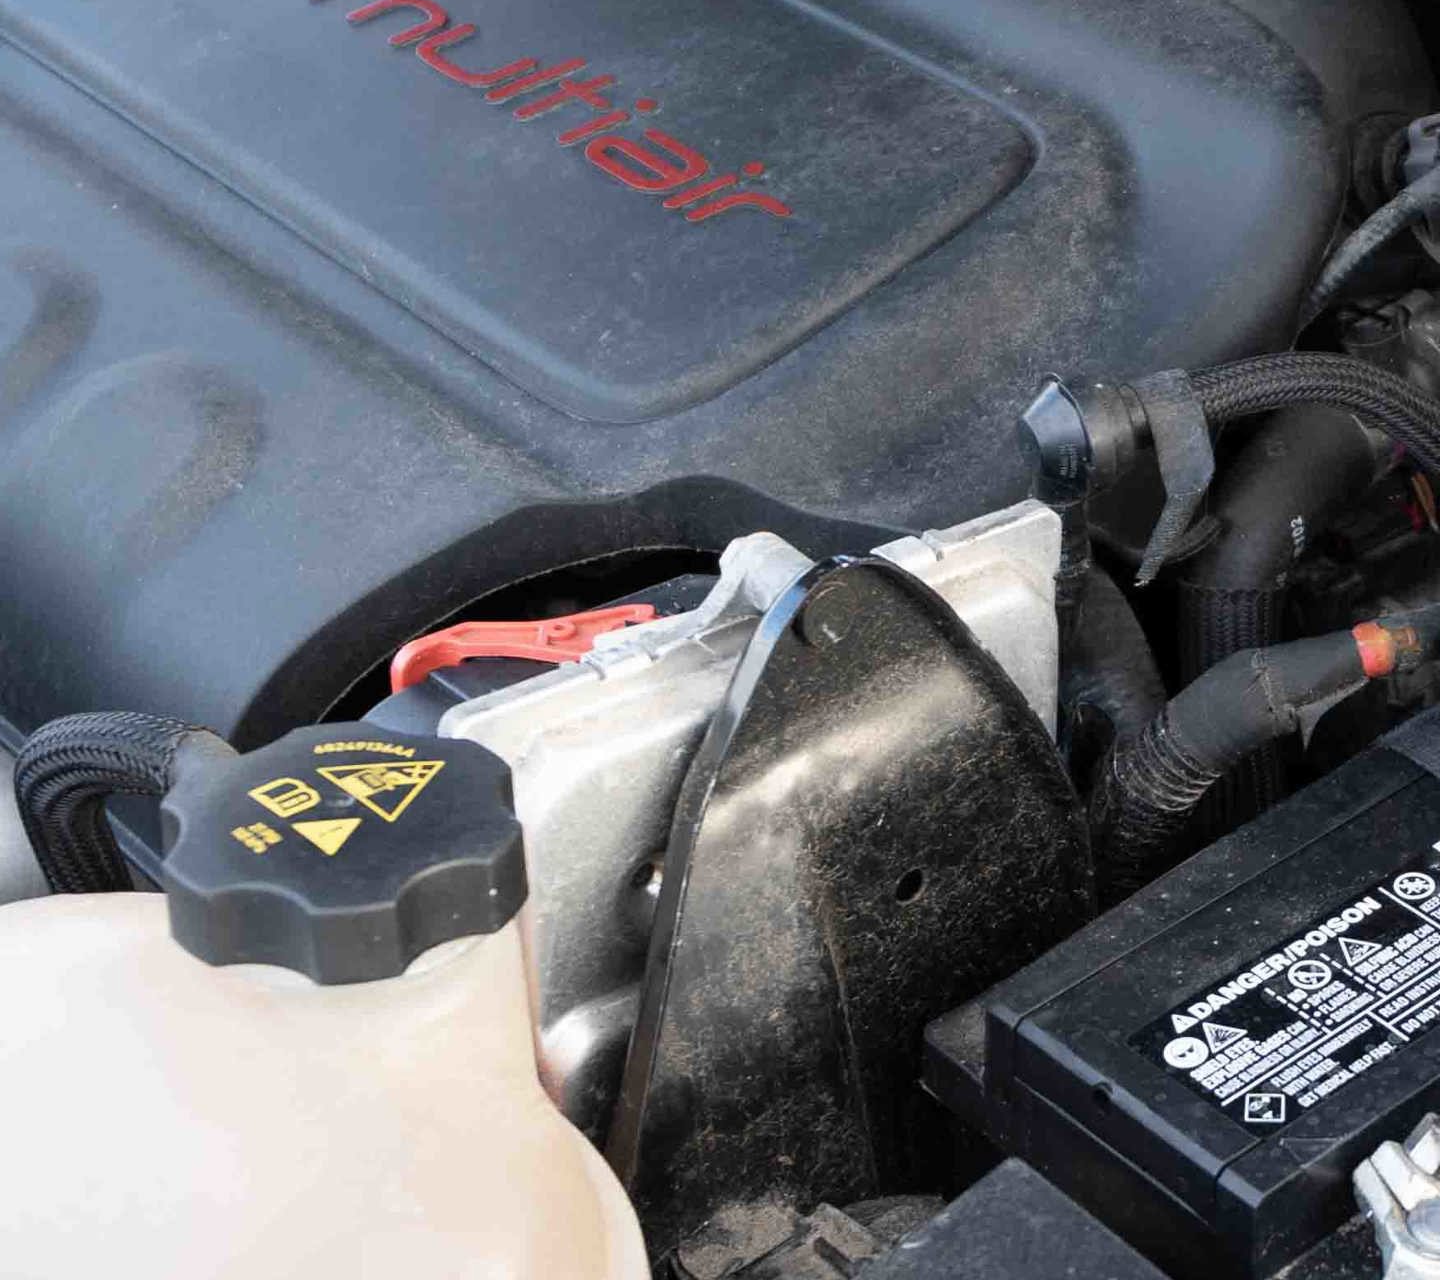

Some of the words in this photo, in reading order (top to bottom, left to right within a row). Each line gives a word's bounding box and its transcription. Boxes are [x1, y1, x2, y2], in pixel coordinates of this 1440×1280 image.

[1394, 933, 1419, 952] ACID
[1414, 924, 1435, 938] CAN
[1187, 896, 1382, 1023] DANGER/POISON
[1368, 962, 1400, 984] CAUSE
[1379, 978, 1398, 991] OR
[1392, 958, 1429, 983] SEVERE
[1304, 981, 1346, 1006] SPARKS
[1318, 988, 1357, 1014] FLAMES
[1330, 992, 1375, 1022] SMOKING
[1378, 996, 1409, 1018] READ
[1401, 1018, 1421, 1033] DO
[1190, 1054, 1232, 1082] SHIELD
[1224, 1037, 1260, 1060] EYES.
[1201, 1050, 1261, 1090] EXPLOSIVE
[1251, 1030, 1292, 1056] GASES
[1286, 1021, 1308, 1036] CAN
[1270, 1065, 1303, 1088] FLUSH
[1296, 1052, 1323, 1070] EYES
[1317, 1018, 1373, 1057] IMMEDIATELY
[1214, 1077, 1245, 1098] CAUSE
[1282, 1076, 1310, 1096] WITH
[1303, 1058, 1340, 1082] WATER.
[1298, 1091, 1319, 1107] GET
[1311, 1069, 1355, 1097] MEDICAL
[1349, 1054, 1377, 1073] HELP
[1369, 1041, 1397, 1060] FAST.
